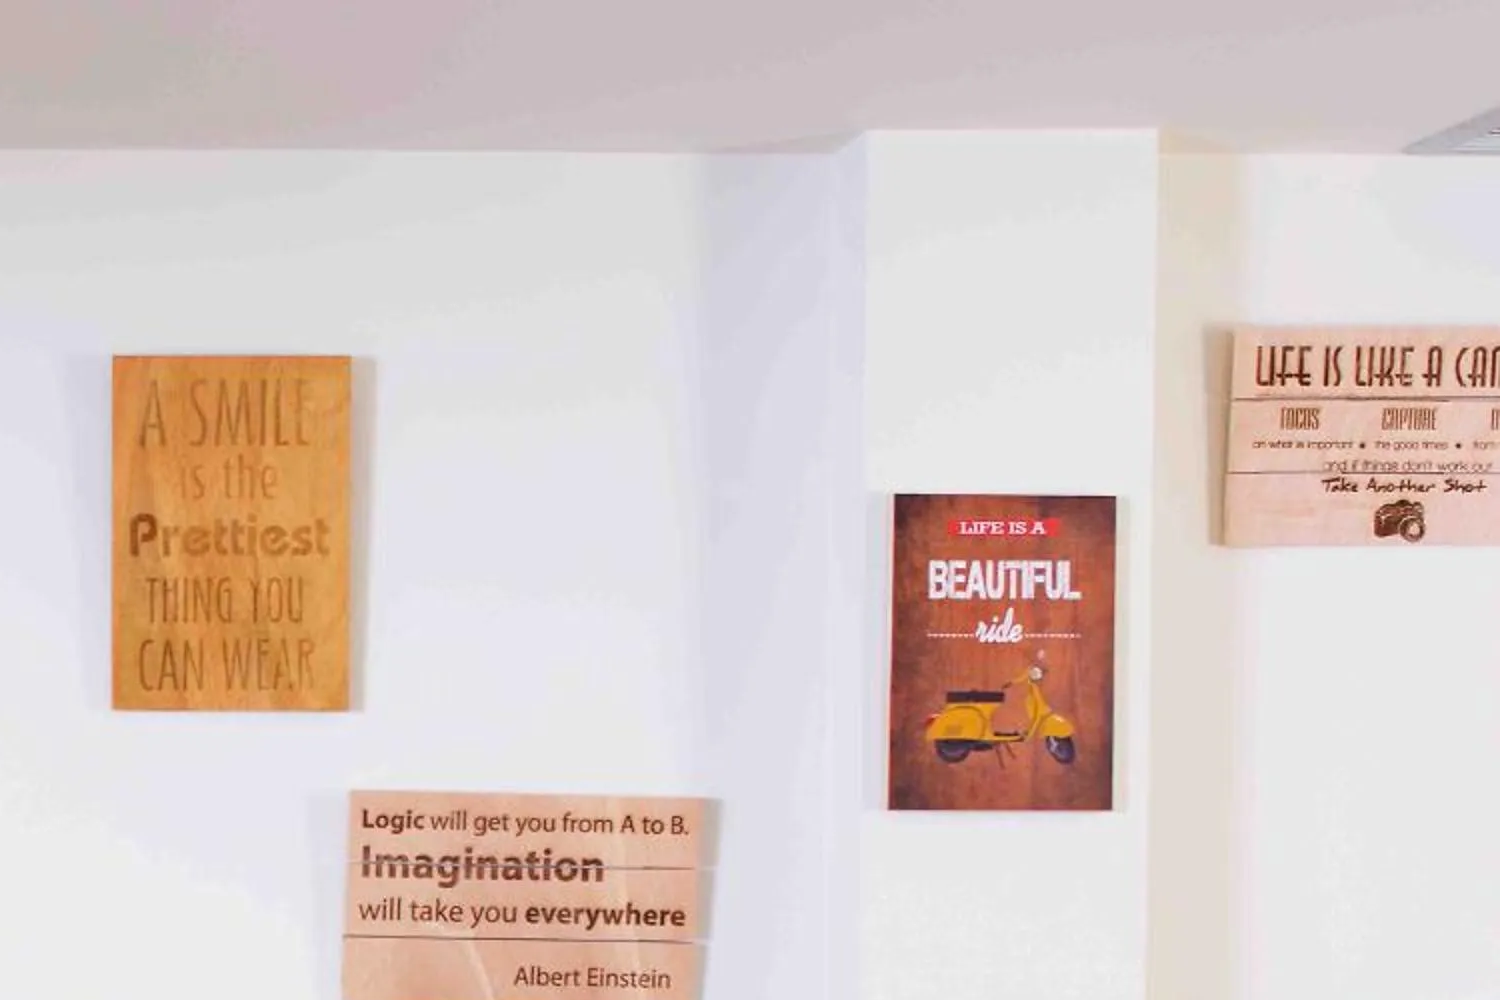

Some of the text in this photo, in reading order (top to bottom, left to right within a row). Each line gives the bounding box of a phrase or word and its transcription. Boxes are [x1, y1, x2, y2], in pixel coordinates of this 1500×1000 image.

[1256, 346, 1313, 387] LIFE
[1323, 346, 1342, 387] IS
[1355, 346, 1414, 387] LIKE
[1422, 346, 1442, 387] A
[139, 376, 312, 449] A SMILE
[181, 454, 278, 500] is the
[1321, 478, 1487, 493] Take Another Shot
[129, 513, 330, 558] Prettiest
[959, 521, 1046, 535] LIFE IS A
[146, 576, 304, 624] THING YOU
[928, 560, 1082, 600] BEAUTIFUL
[975, 608, 1023, 643] ride
[139, 638, 316, 691] CAN WEAR
[361, 810, 425, 834] Logic
[430, 811, 468, 831] will
[474, 814, 510, 836] get
[515, 816, 556, 836] you
[562, 812, 613, 834] from
[620, 815, 636, 833] A
[642, 816, 665, 834] to
[361, 846, 605, 888] Imagination
[358, 898, 687, 930] will take you everywhere
[513, 966, 671, 990] Albert Einstein
